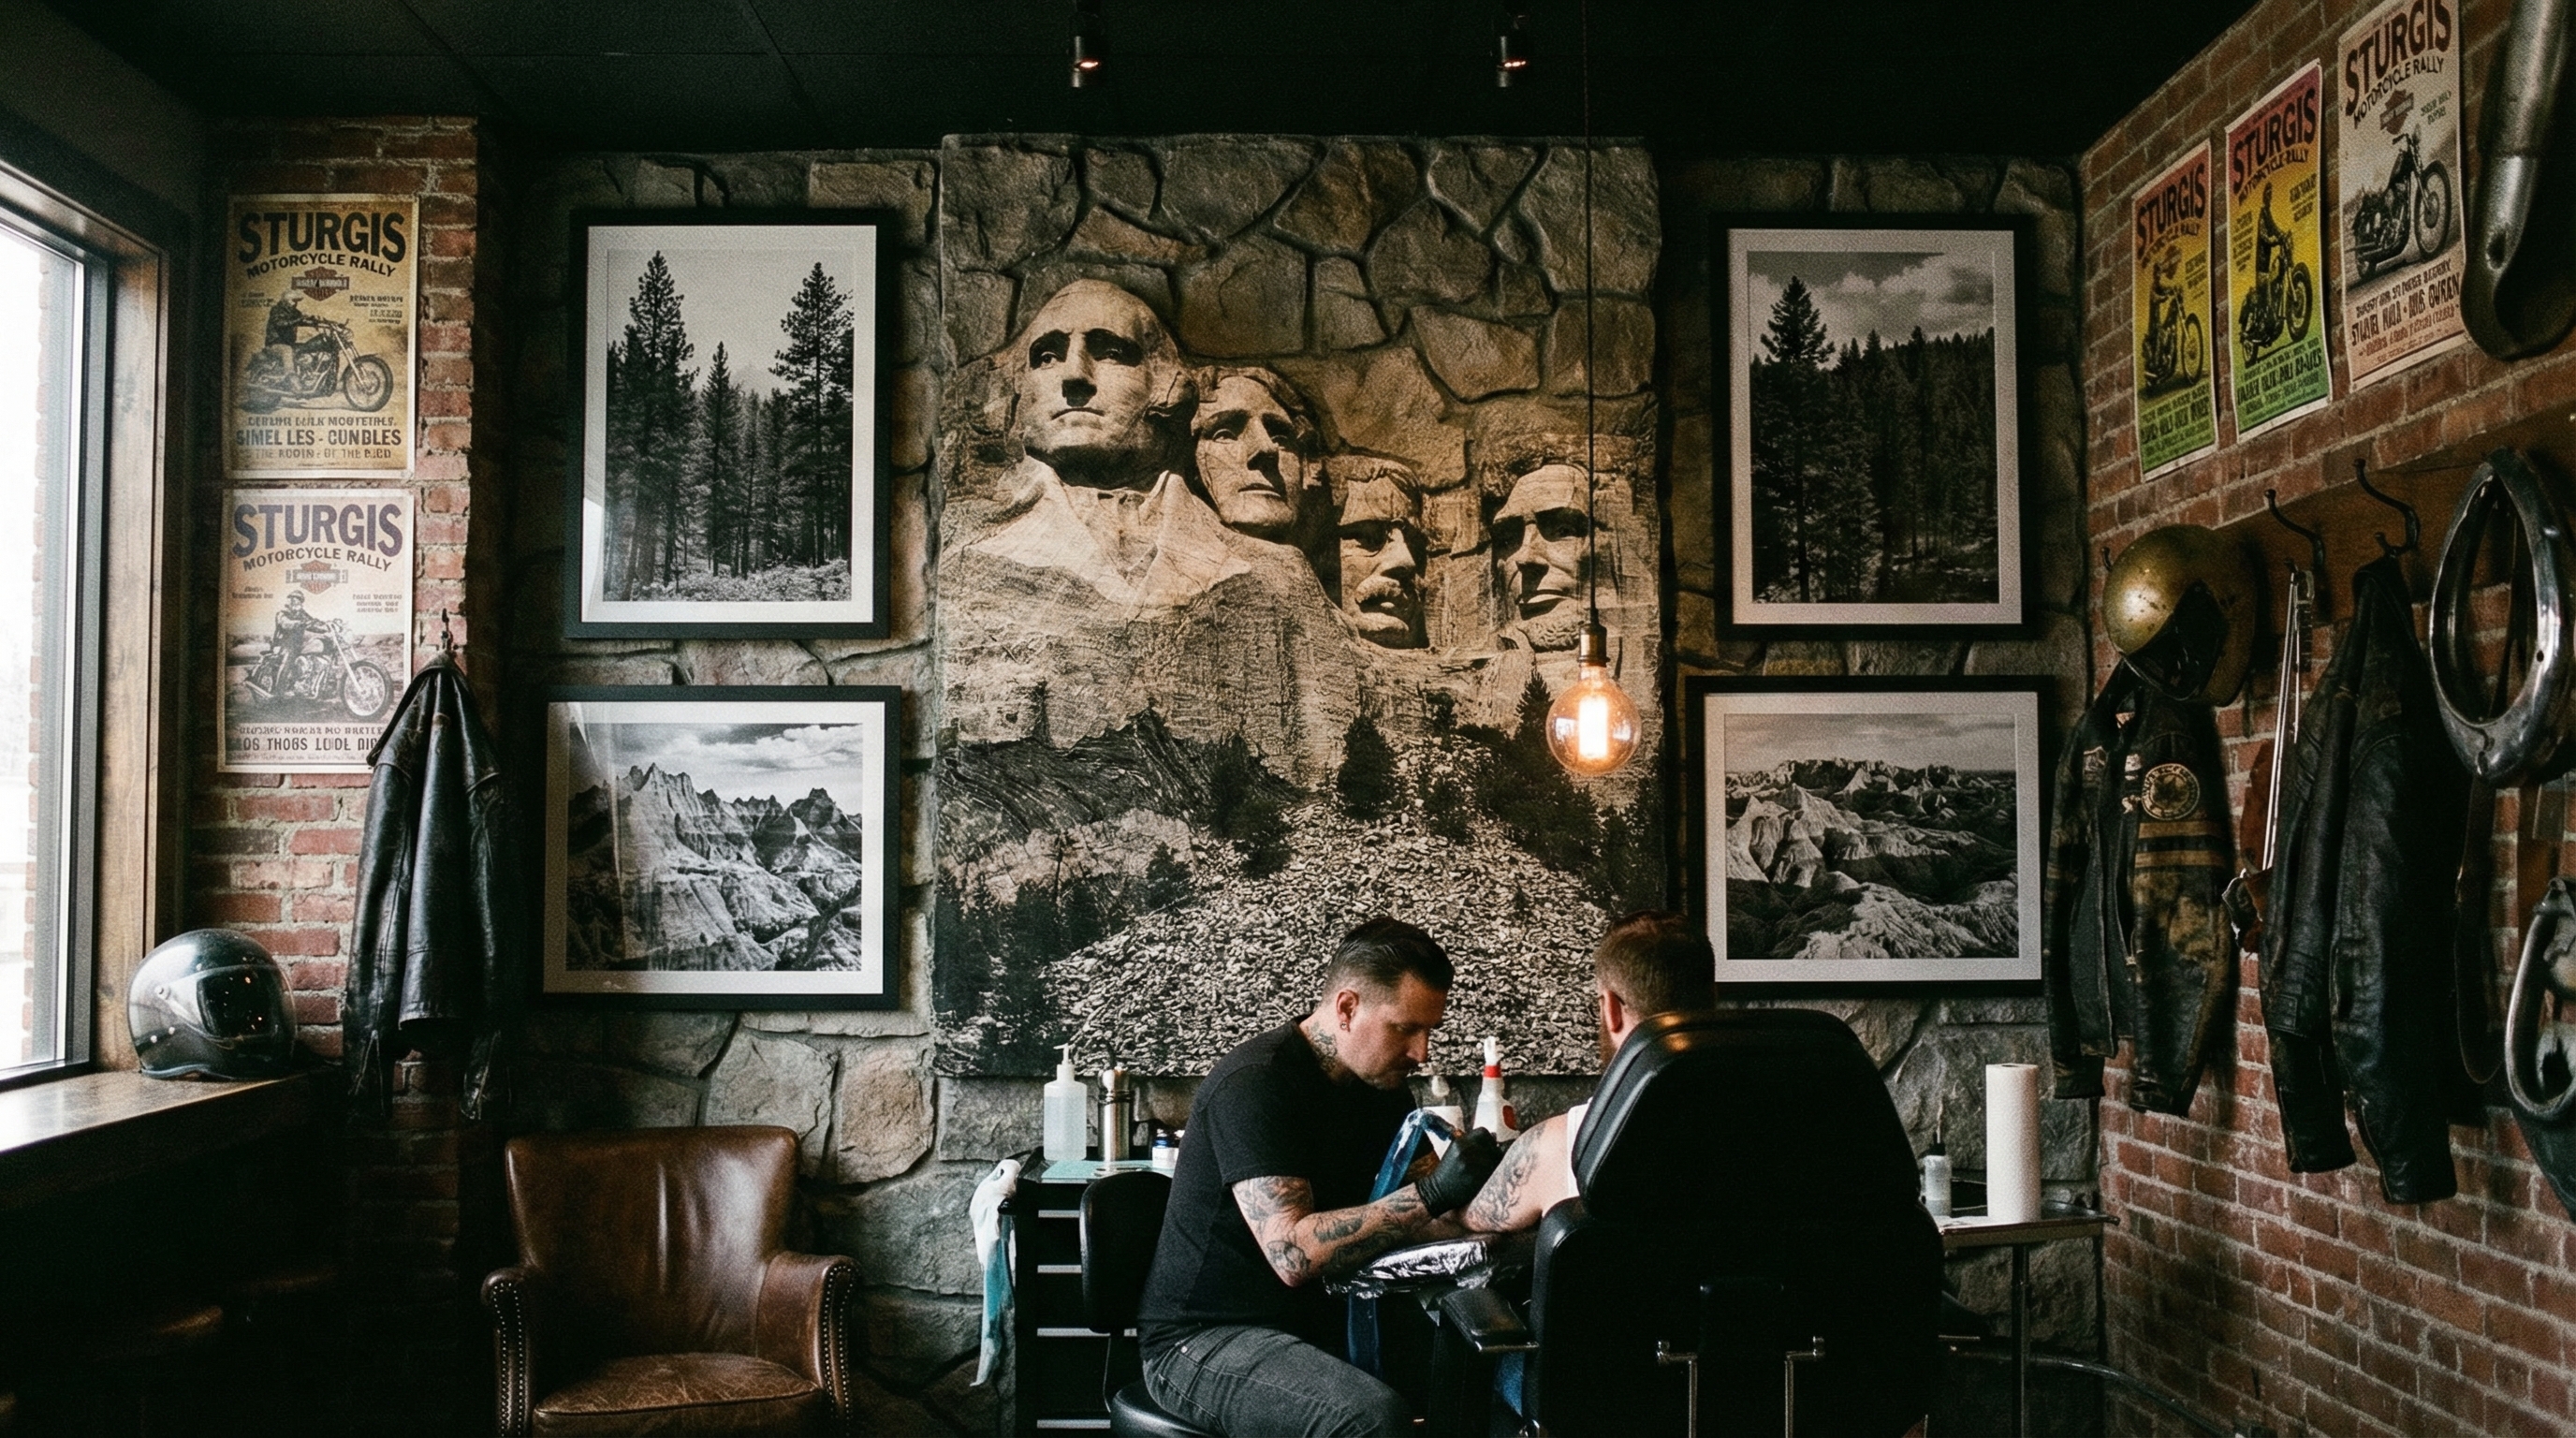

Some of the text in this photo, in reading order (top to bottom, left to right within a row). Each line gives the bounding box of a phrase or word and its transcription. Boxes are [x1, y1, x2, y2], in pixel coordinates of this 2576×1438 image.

[2346, 0, 2451, 116] STURGIS
[2413, 56, 2444, 75] RALLY
[2233, 88, 2316, 194] STURGIS
[239, 212, 406, 263] STURGIS
[2137, 163, 2205, 260] STURGIS
[247, 253, 396, 279] MOTORCYCLE RALLY
[232, 504, 403, 558] STURGIS
[243, 547, 392, 572] MOTORCYCLE RALLY
